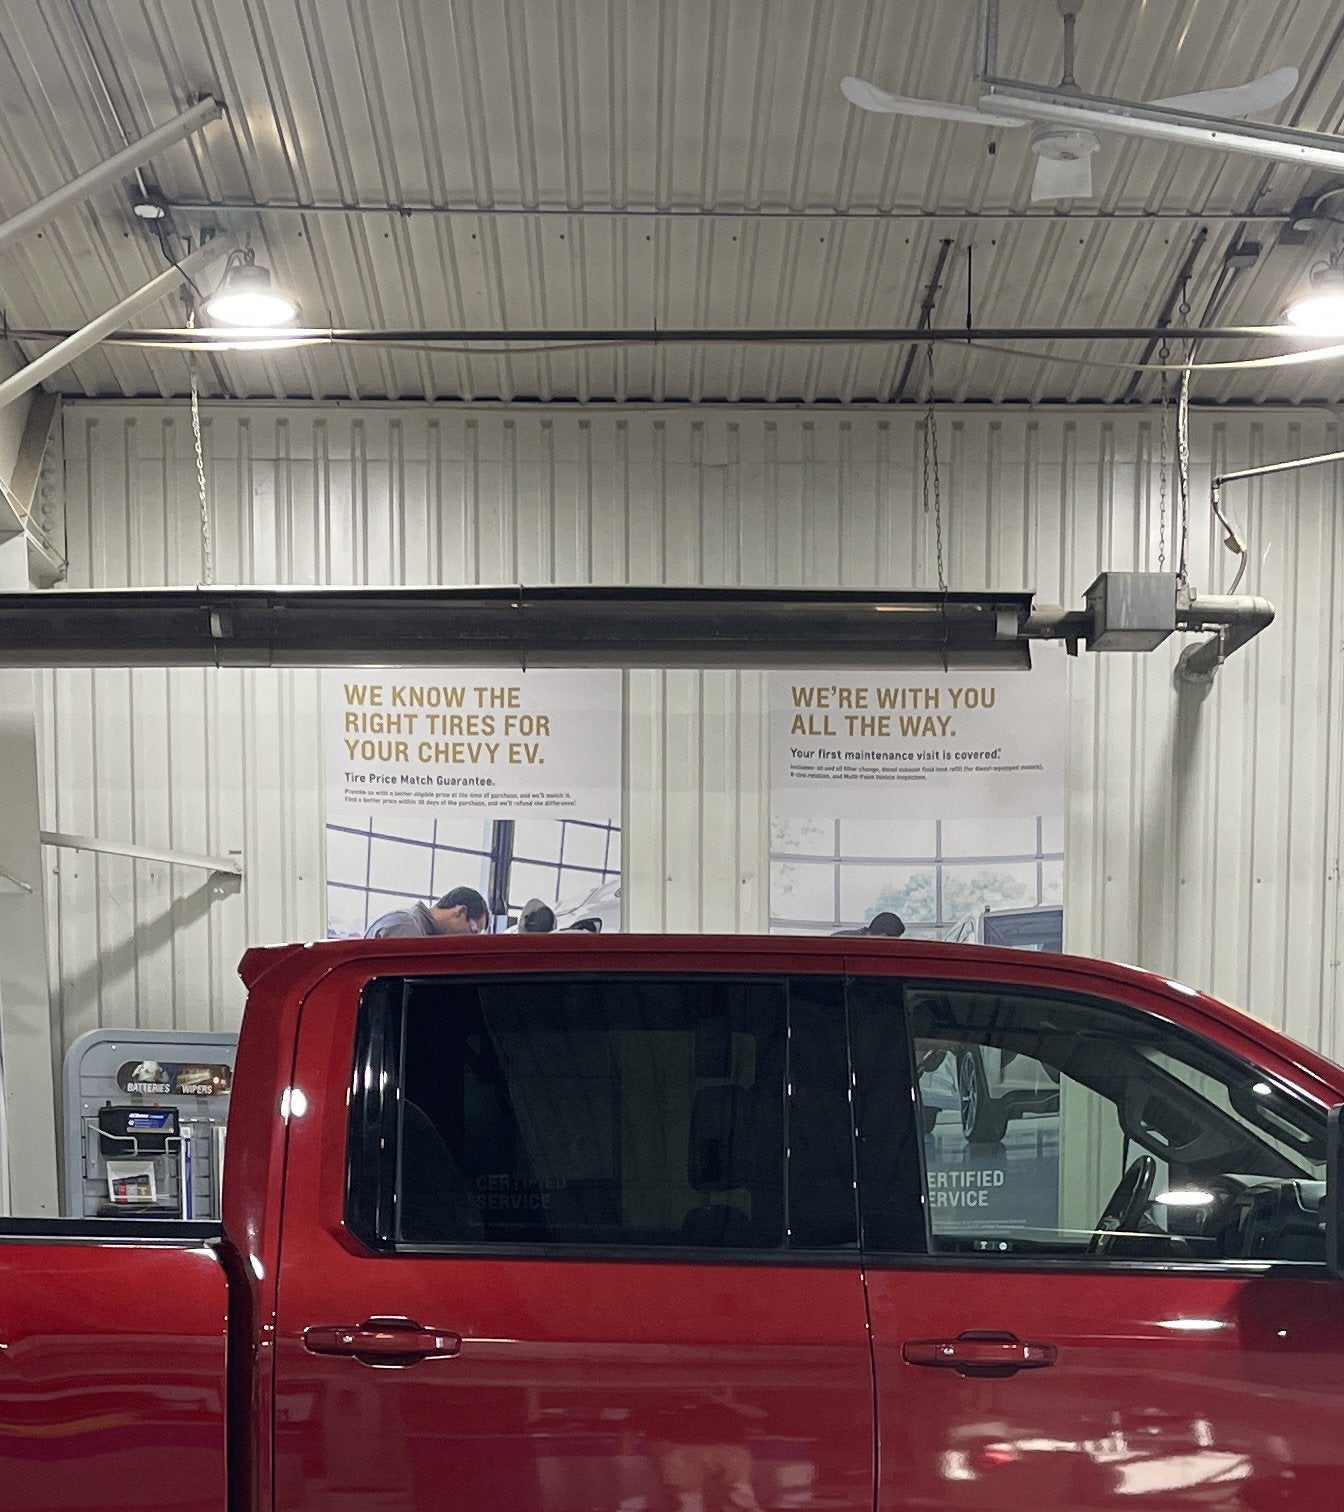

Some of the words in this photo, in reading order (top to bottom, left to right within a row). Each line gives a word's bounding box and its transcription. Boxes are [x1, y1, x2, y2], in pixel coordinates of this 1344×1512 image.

[344, 684, 383, 707] WE
[391, 685, 466, 708] KNOW
[473, 687, 521, 709] THE
[791, 686, 868, 709] WE'RE
[876, 688, 940, 709] WITH
[948, 687, 996, 709] YOU
[344, 712, 418, 735] RIGHT
[426, 714, 495, 737] TIRES
[504, 715, 550, 737] FOR
[790, 714, 837, 736] ALL
[844, 715, 891, 737] THE
[899, 715, 956, 738] WAY.
[344, 739, 409, 763] YOUR
[418, 741, 500, 764] CHEVY
[508, 743, 545, 765] EV.
[790, 748, 814, 759] Your
[818, 748, 842, 760] first
[844, 749, 914, 761] maintenance
[917, 749, 940, 761] visit
[942, 749, 952, 761] is
[344, 772, 366, 784] Tire
[369, 773, 397, 785] Price
[400, 774, 433, 786] Match
[436, 775, 495, 787] Guarantee.
[126, 1082, 171, 1094] BATTERIES
[181, 1084, 213, 1095] WIPERS
[927, 1170, 1004, 1188] ERTIFIED
[929, 1190, 989, 1207] ERVICE
